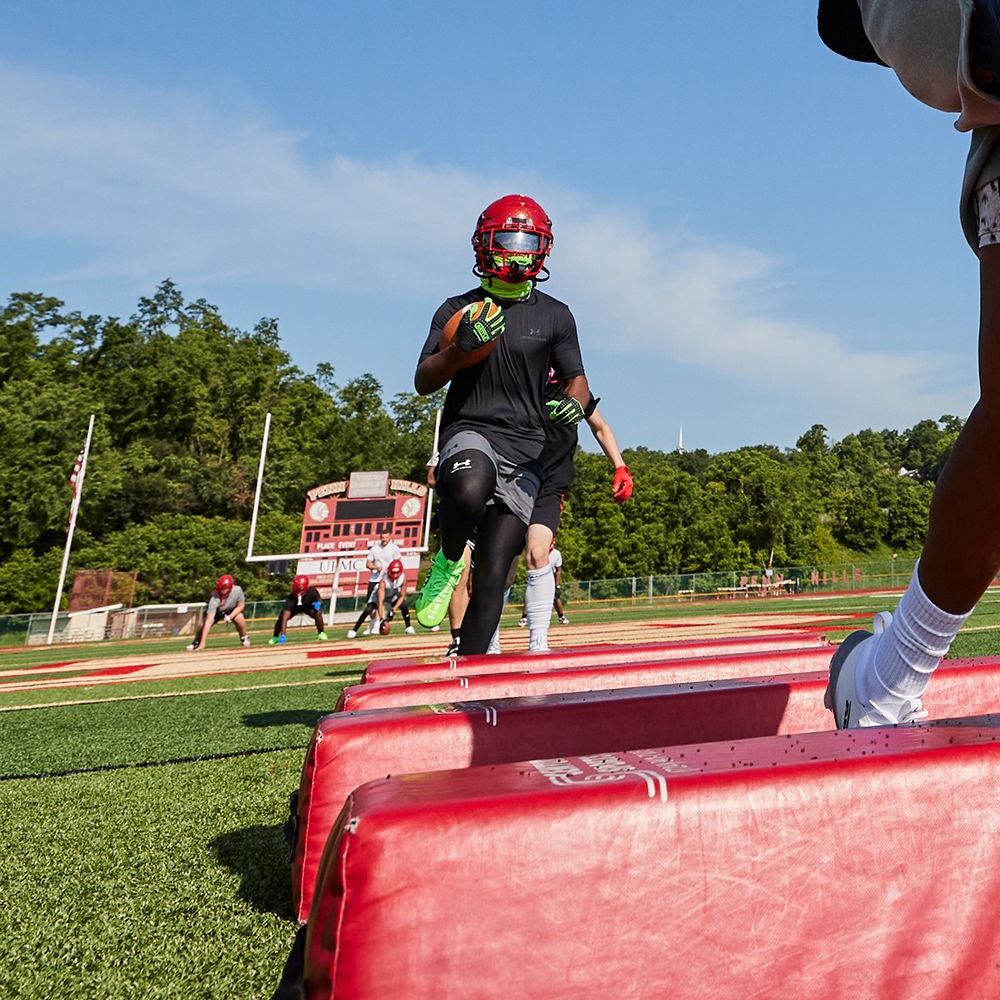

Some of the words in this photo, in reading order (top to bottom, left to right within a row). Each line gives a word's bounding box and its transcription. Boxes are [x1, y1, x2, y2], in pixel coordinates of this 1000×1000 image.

[316, 541, 335, 550] PLACE
[338, 540, 357, 549] EVENT
[811, 568, 861, 585] HILLS
